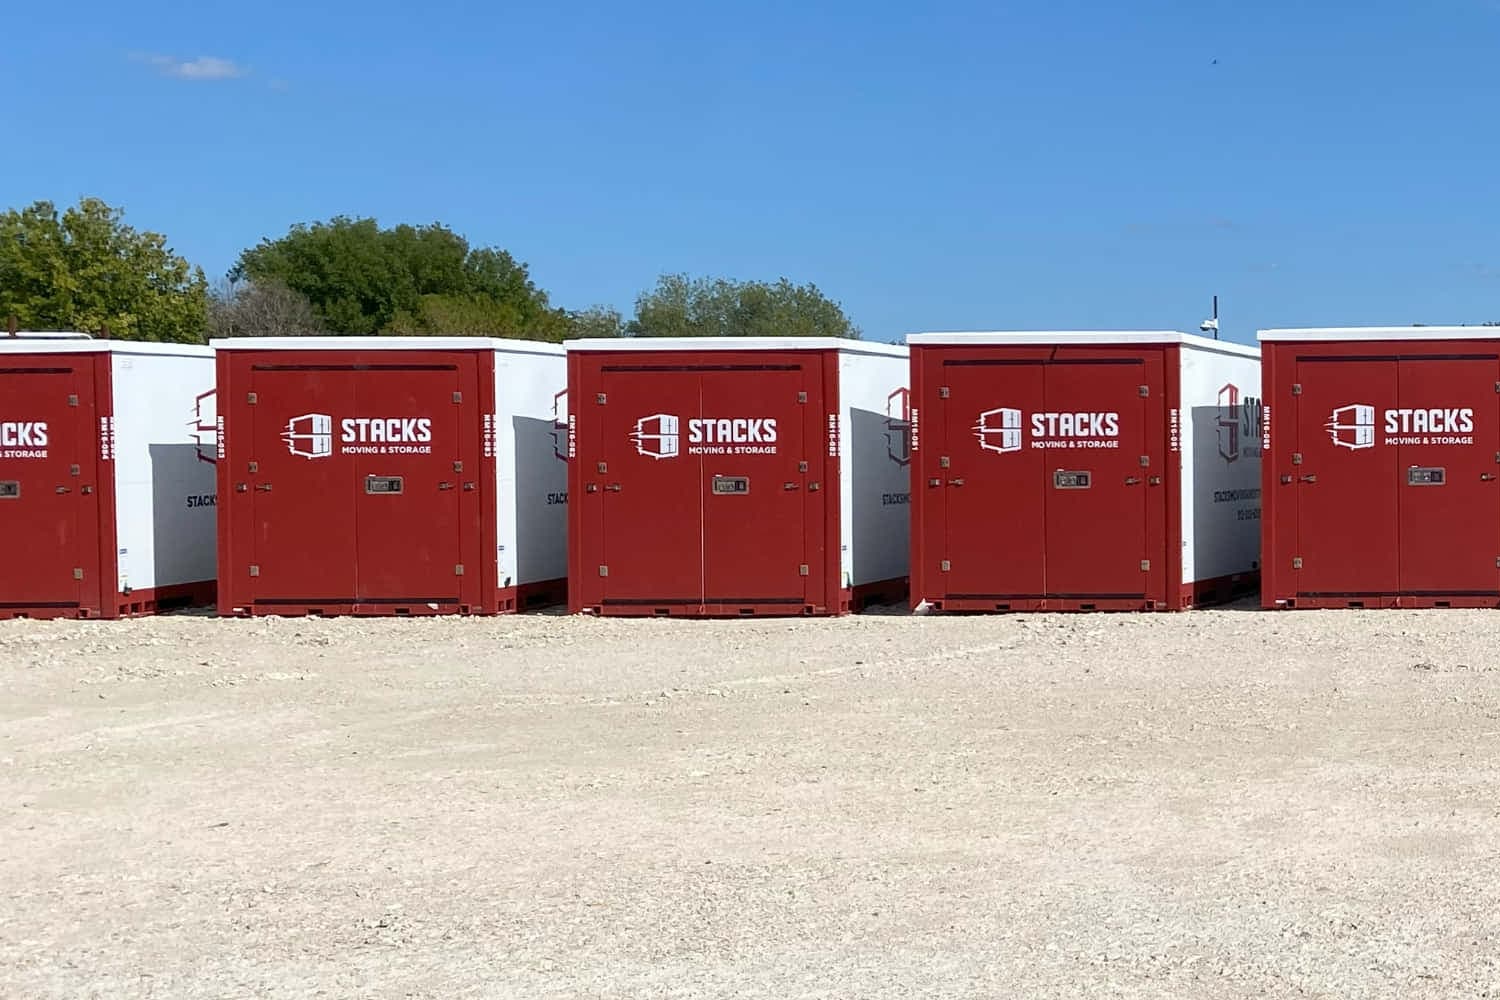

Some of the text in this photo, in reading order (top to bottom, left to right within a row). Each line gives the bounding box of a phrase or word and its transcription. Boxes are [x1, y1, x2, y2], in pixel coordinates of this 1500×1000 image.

[1031, 412, 1119, 437] STACKS
[1384, 408, 1474, 434] STACKS
[0, 421, 48, 447] CKS
[341, 418, 432, 443] STACKS
[688, 418, 777, 443] STACKS
[1031, 440, 1119, 449] MOVING & STORAGE
[1384, 436, 1473, 445] MOVING & STORAGE
[4, 450, 48, 458] STORAGE
[341, 445, 432, 454] MOVING & STORAGE
[688, 446, 777, 455] MOVING & STORAGE
